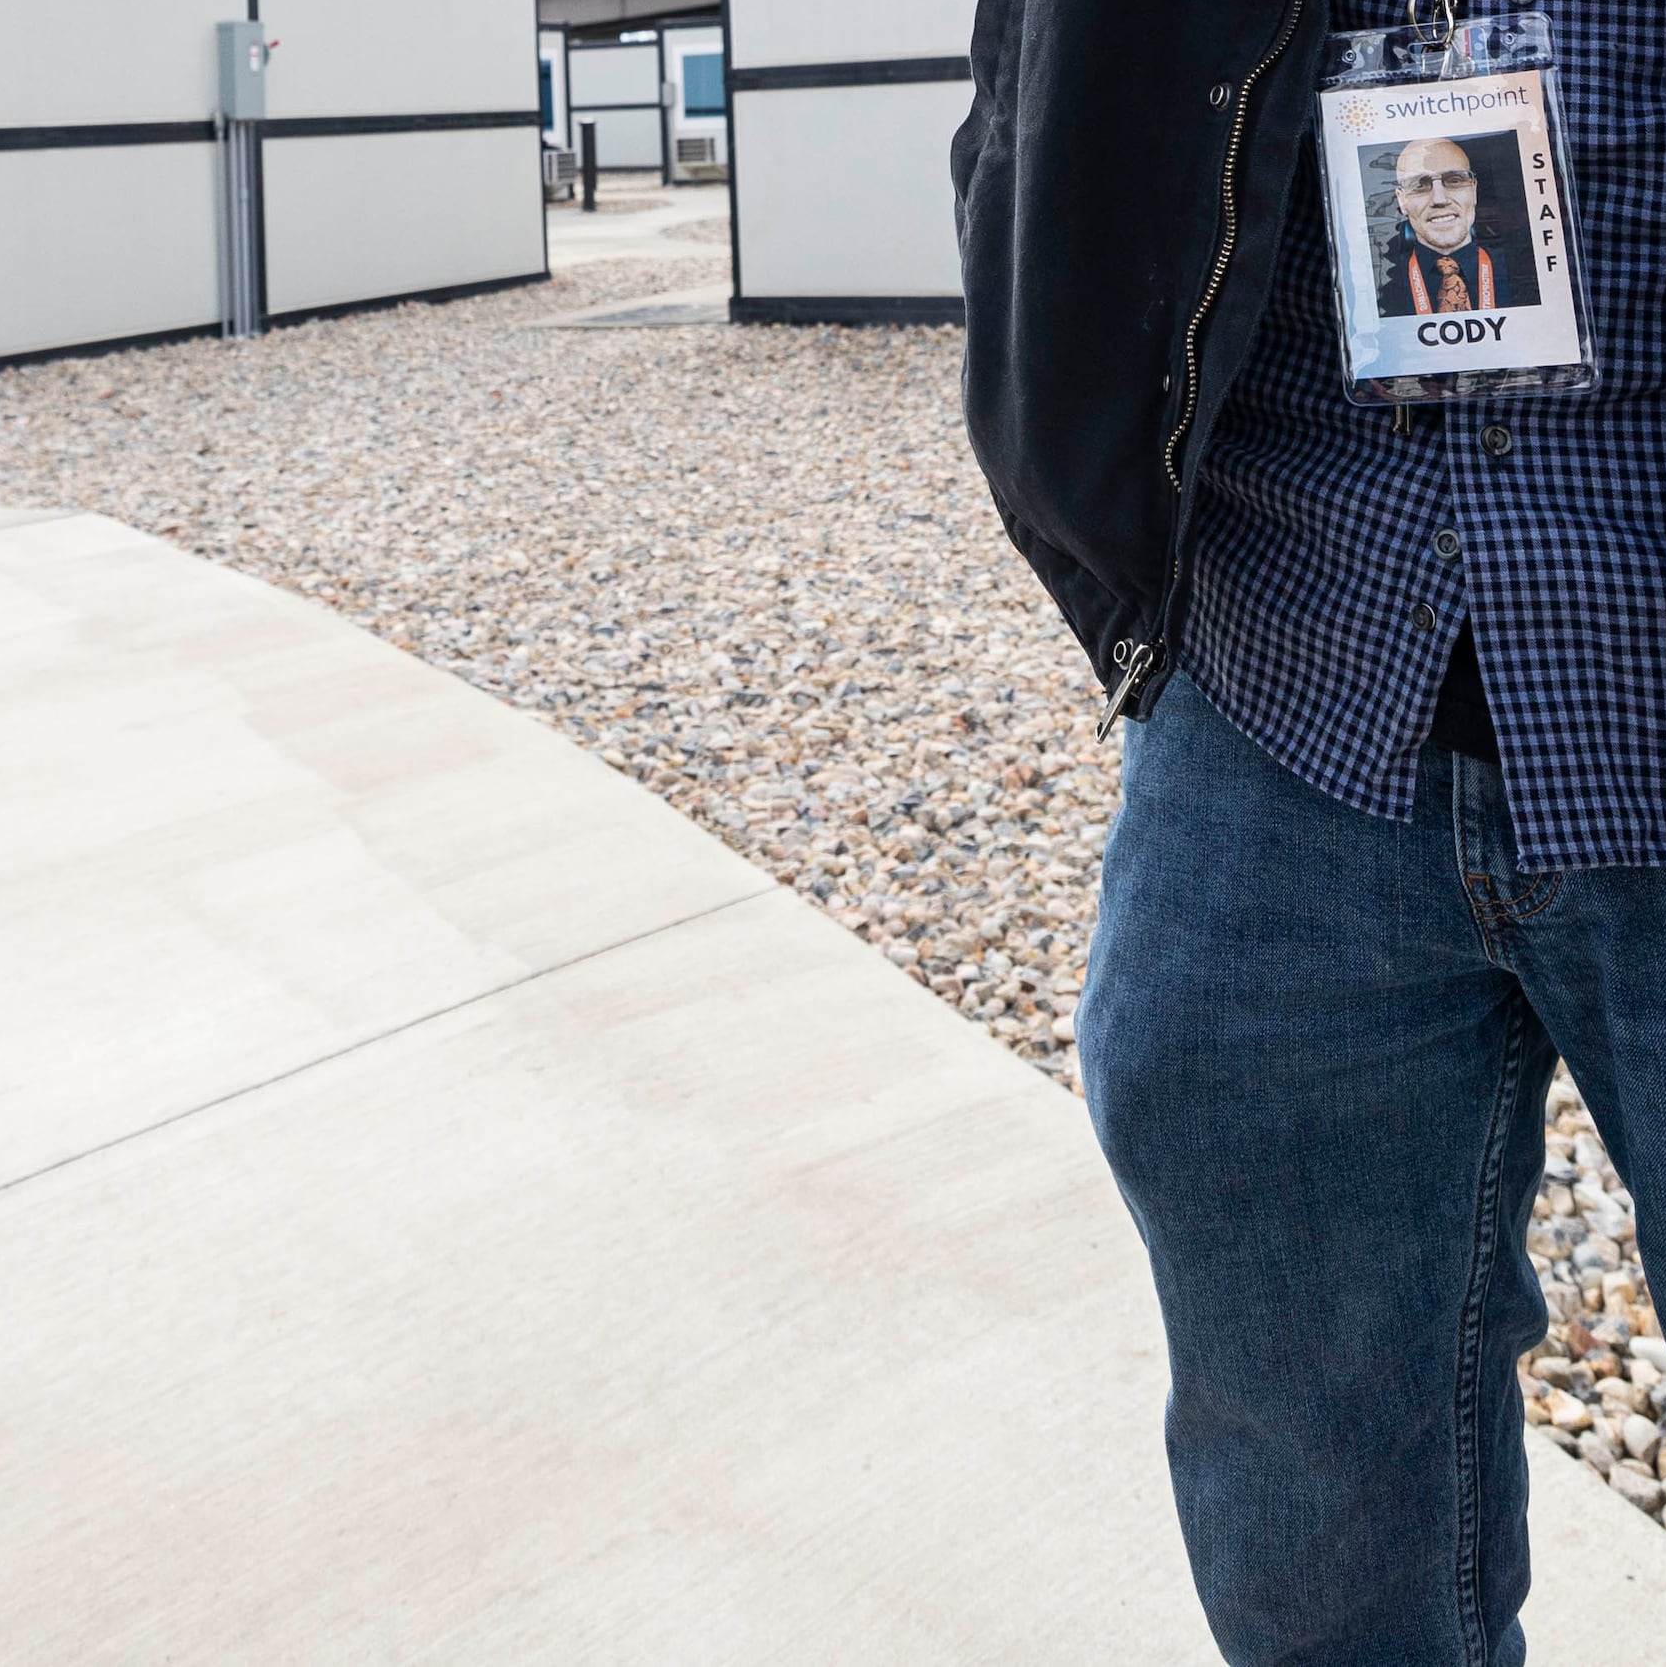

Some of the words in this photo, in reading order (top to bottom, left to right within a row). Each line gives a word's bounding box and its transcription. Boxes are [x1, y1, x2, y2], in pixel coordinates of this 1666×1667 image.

[1385, 86, 1530, 120] switchpoint
[1533, 153, 1558, 272] STAFF
[1417, 316, 1507, 346] CODY
